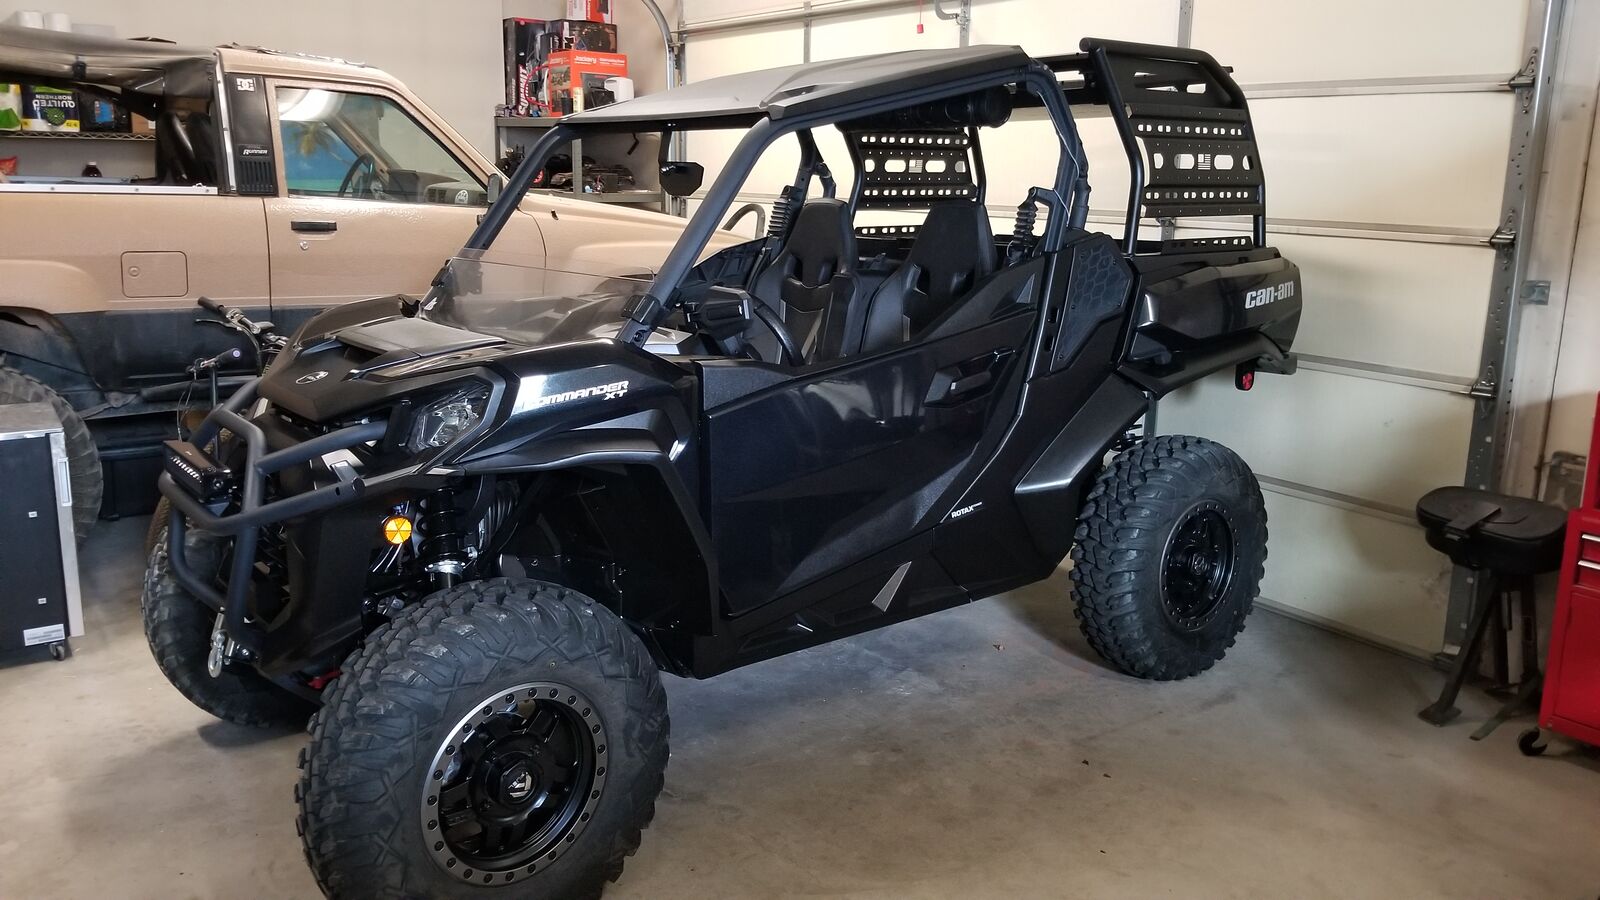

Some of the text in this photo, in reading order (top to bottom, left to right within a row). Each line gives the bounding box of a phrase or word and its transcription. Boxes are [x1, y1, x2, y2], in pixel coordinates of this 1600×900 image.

[518, 66, 529, 115] SUMMIT
[32, 99, 75, 109] QUILTED
[1244, 281, 1294, 309] can-am
[530, 380, 629, 405] OMMANDER
[603, 389, 629, 400] XT
[951, 503, 979, 518] ROTAX
